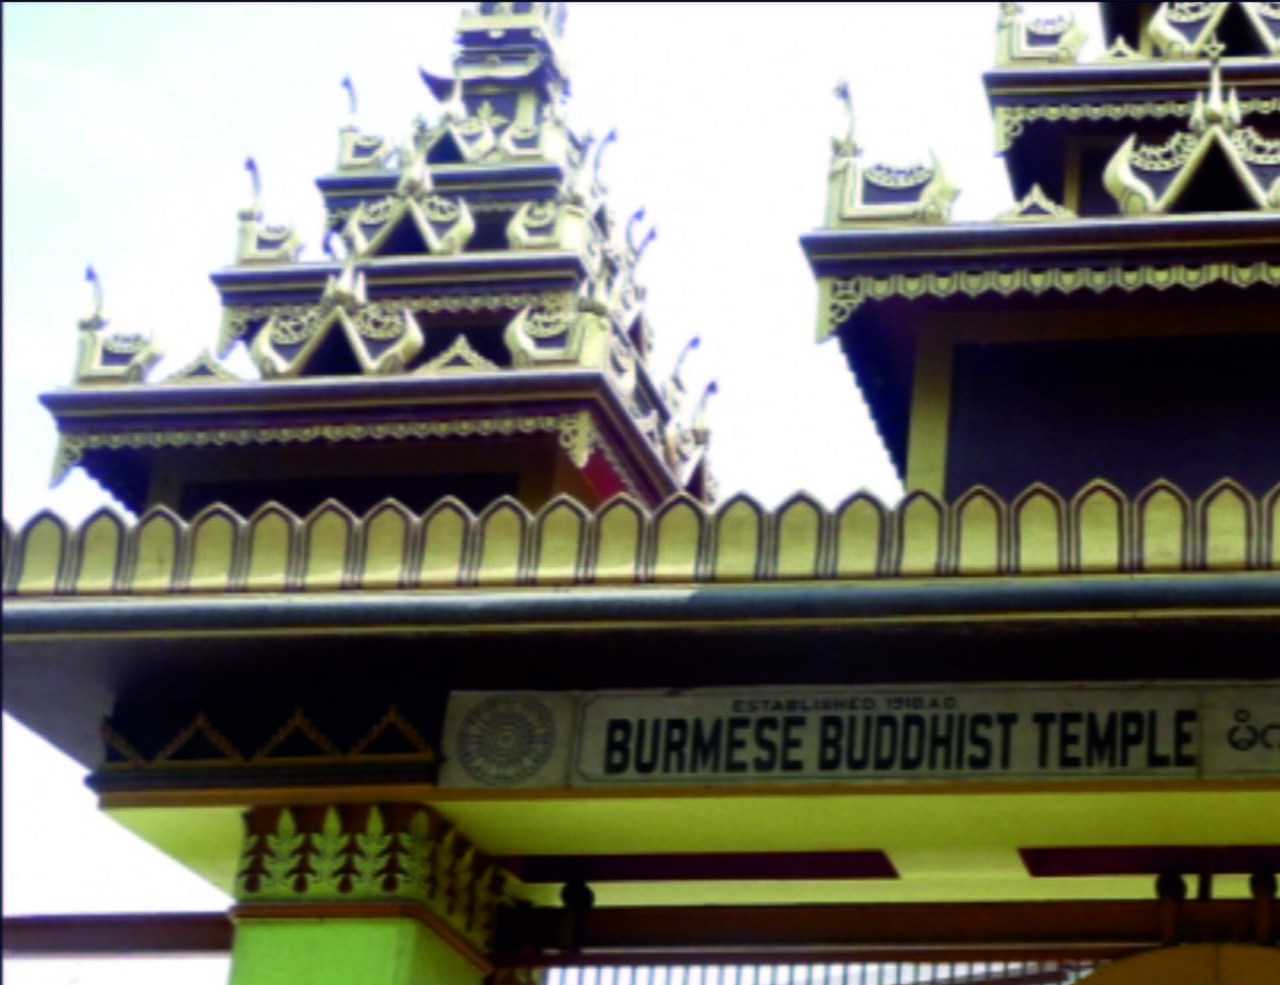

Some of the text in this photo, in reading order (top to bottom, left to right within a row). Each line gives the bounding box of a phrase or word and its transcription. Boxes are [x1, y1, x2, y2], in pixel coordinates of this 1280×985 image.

[606, 710, 1198, 773] BURMESE BUDDHIST TEMPLE
